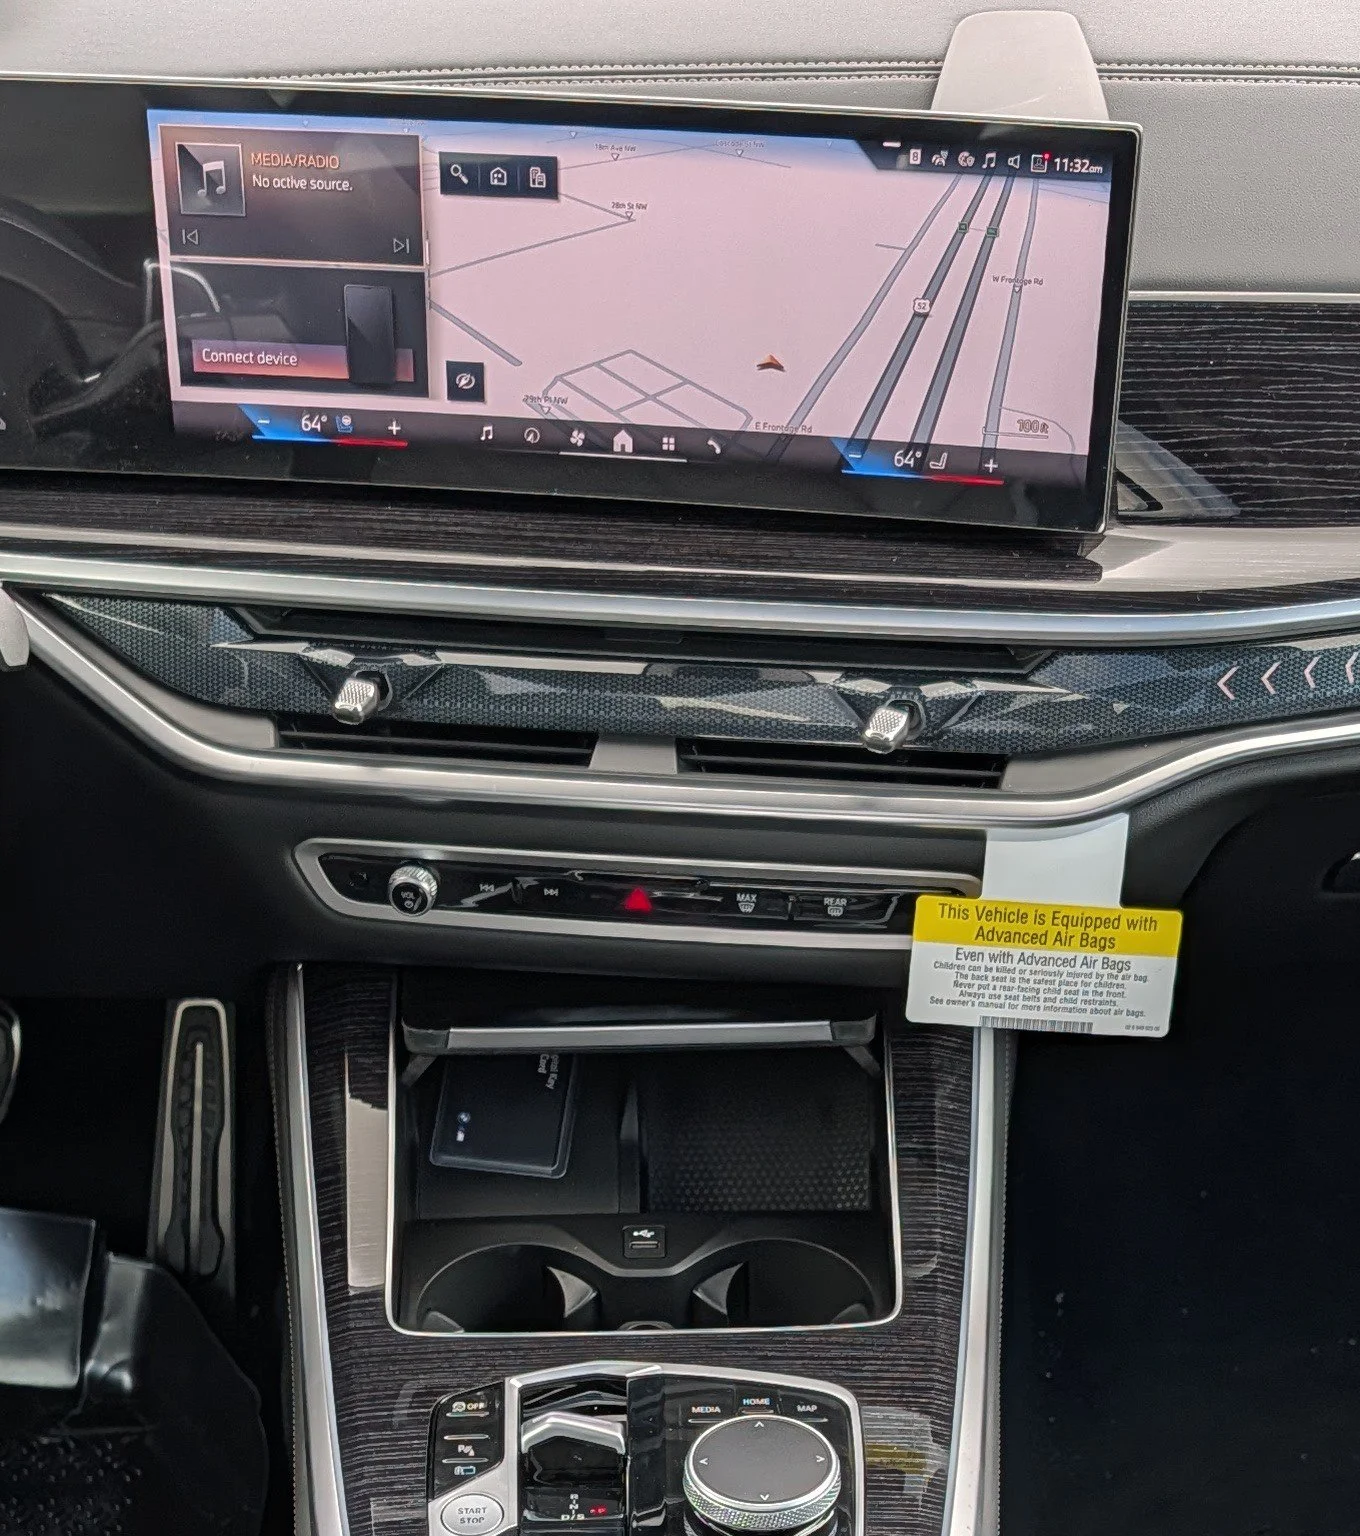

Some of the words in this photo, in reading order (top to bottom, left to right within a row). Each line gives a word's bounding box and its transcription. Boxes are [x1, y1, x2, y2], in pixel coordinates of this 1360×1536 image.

[251, 152, 340, 169] MEDIA/RADIO
[252, 174, 270, 188] No
[272, 175, 308, 190] active
[309, 178, 354, 192] source.
[202, 348, 254, 364] Connect
[256, 351, 298, 366] device
[301, 415, 328, 432] 64°
[755, 421, 761, 431] E
[801, 425, 813, 433] Rd
[894, 450, 922, 468] 64°
[736, 893, 757, 902] MAX
[823, 897, 848, 907] REAR
[938, 902, 970, 921] This
[975, 905, 1029, 925] Vehicle
[1033, 909, 1047, 926] is
[1051, 910, 1122, 931] Equipped
[1126, 915, 1158, 932] with
[975, 925, 1049, 946] Advanced
[1052, 930, 1075, 947] Air
[1079, 932, 1116, 952] Bags
[955, 947, 985, 963] Even
[988, 950, 1014, 965] with
[1017, 952, 1078, 969] Advanced
[1080, 956, 1099, 970] Air
[1101, 956, 1132, 974] Bags
[933, 960, 966, 971] Children
[967, 964, 982, 972] can
[983, 964, 994, 973] be
[995, 965, 1017, 975] killed
[1029, 968, 1064, 979] seriously
[1066, 970, 1093, 980] injured
[1095, 972, 1105, 982] by
[1106, 972, 1119, 981] the
[1120, 973, 1132, 981] air
[955, 970, 969, 981] The
[970, 972, 989, 982] back
[991, 974, 1008, 983] seat
[1018, 975, 1031, 984] the
[1032, 977, 1057, 987] safest
[1058, 979, 1079, 989] place
[1080, 979, 1092, 988] for
[1093, 980, 1127, 990] children.
[952, 980, 975, 990] Never
[977, 983, 991, 992] put
[998, 984, 1041, 996] rear-facing
[1042, 986, 1062, 995] child
[1063, 989, 1080, 997] seat
[1081, 989, 1090, 997] in
[1091, 989, 1104, 998] the
[1105, 990, 1127, 999] front.
[959, 989, 986, 1000] Always
[1003, 993, 1021, 1002] seat
[1022, 993, 1041, 1003] belts
[1042, 994, 1058, 1003] and
[1059, 996, 1078, 1005] child
[1080, 998, 1119, 1008] restraints.
[929, 995, 944, 1005] See
[945, 998, 976, 1008] owner's
[977, 999, 1006, 1010] manual
[1007, 1002, 1020, 1011] for
[1021, 1002, 1042, 1012] more
[1043, 1003, 1088, 1014] information
[1089, 1006, 1113, 1016] about
[1114, 1008, 1125, 1017] air
[1126, 1008, 1146, 1018] bags.
[691, 1406, 721, 1414] MEDIA
[796, 1404, 818, 1412] MAP
[458, 1507, 487, 1515] START
